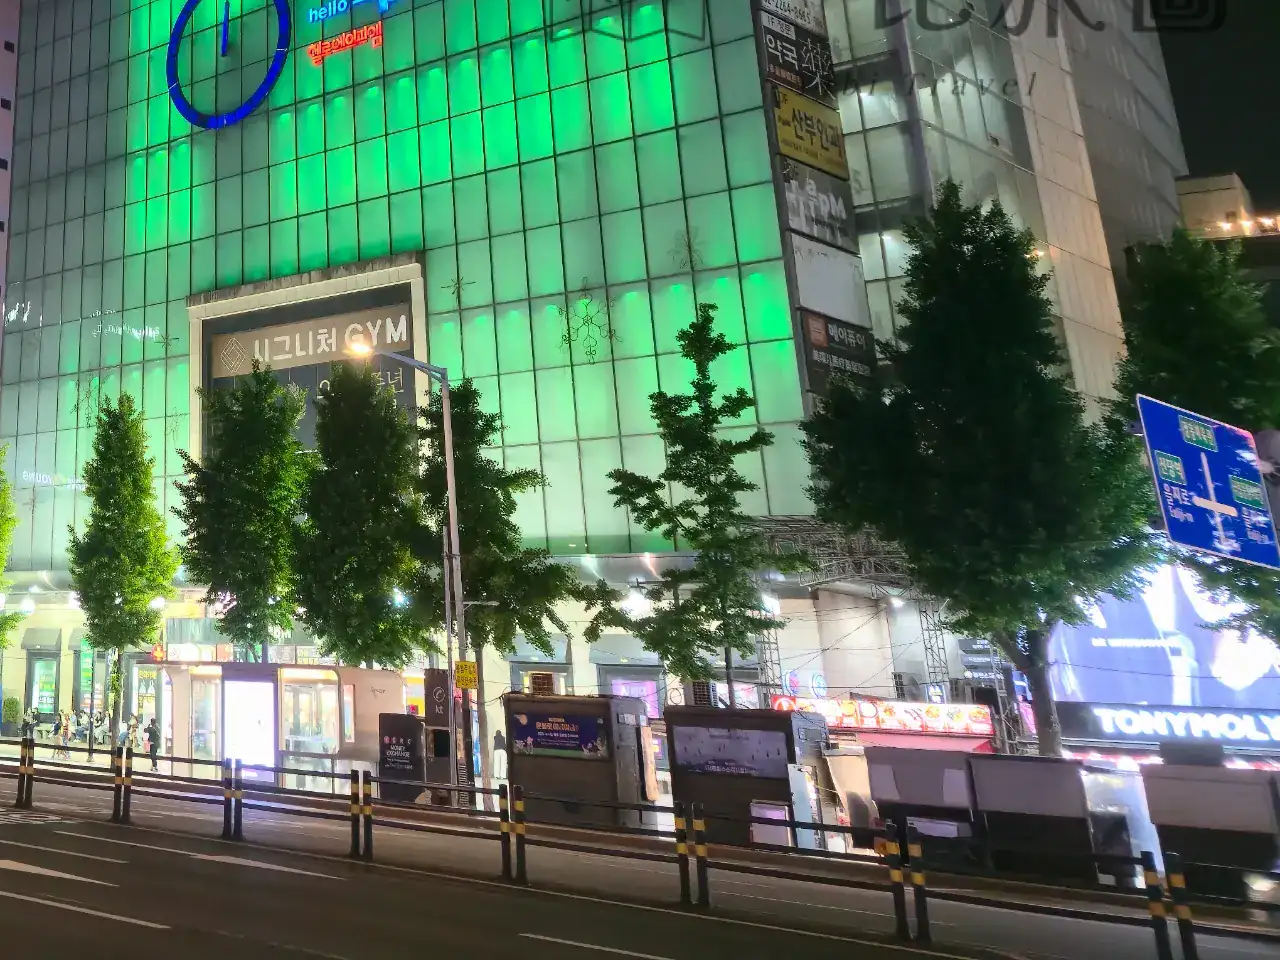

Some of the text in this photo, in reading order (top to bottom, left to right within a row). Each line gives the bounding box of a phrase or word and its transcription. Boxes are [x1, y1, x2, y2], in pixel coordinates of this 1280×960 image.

[309, 0, 348, 23] hello
[766, 34, 799, 71] 약국
[254, 314, 407, 362] 시그니처 GYM
[435, 704, 444, 715] kt
[1093, 707, 1280, 741] TONYMOLY
